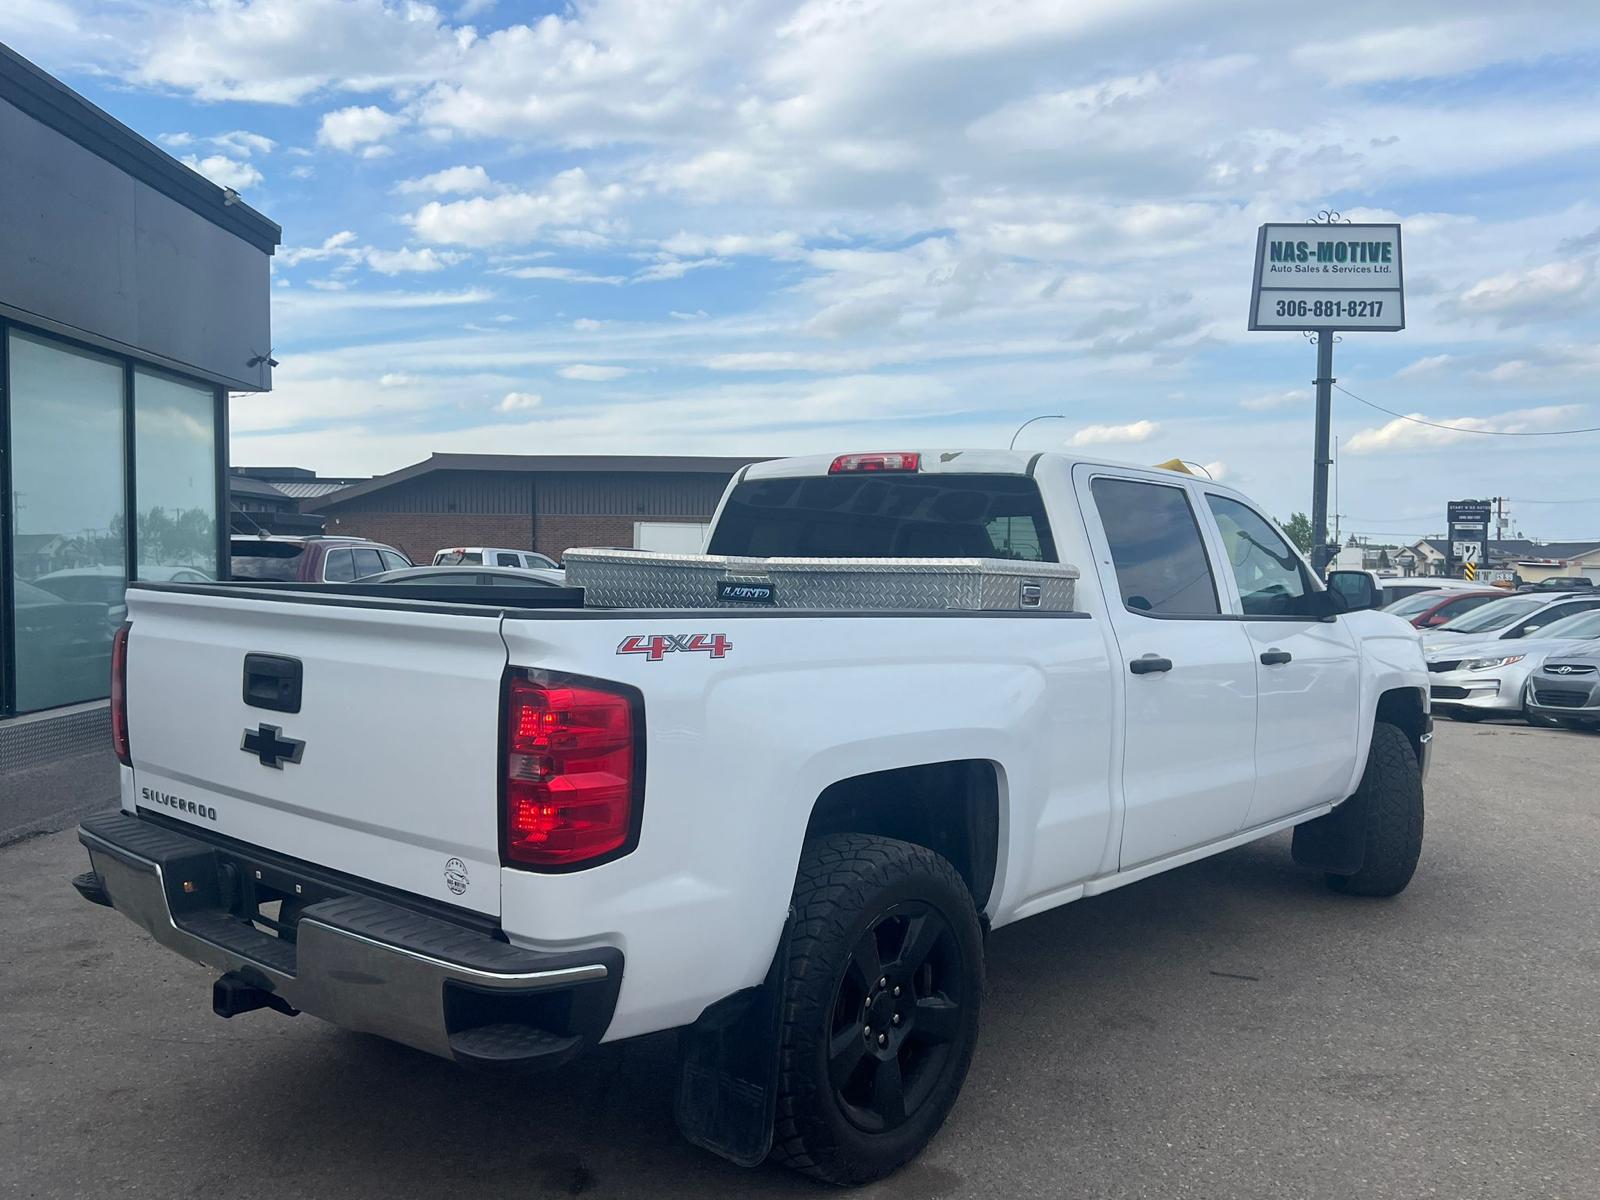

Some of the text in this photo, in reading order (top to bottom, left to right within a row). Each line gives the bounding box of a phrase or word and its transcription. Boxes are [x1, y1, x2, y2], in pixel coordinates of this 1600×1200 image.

[1270, 240, 1392, 263] NAS-MOTIVE
[1270, 265, 1392, 274] Auto Sales & Services Ltd.
[1276, 300, 1383, 318] 306-881-8217
[723, 586, 770, 598] LUND
[142, 787, 217, 821] SILVERADO
